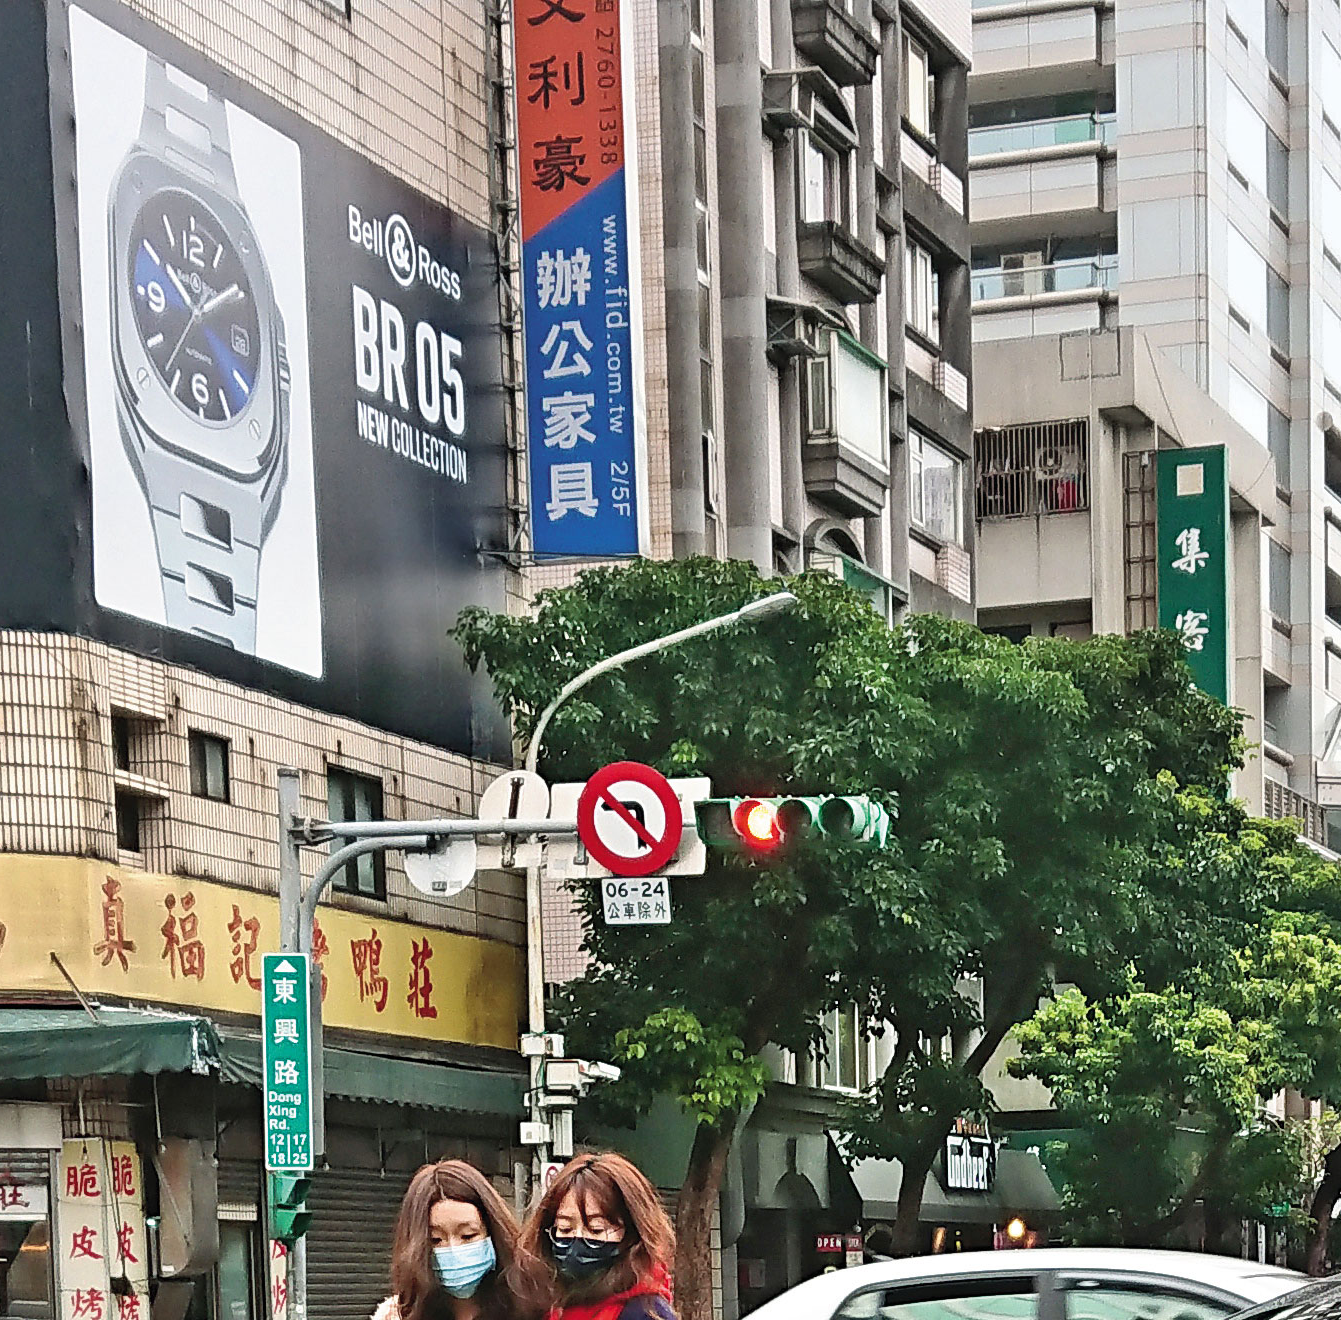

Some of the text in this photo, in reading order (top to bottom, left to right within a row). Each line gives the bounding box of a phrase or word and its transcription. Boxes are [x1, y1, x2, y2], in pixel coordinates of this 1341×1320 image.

[595, 27, 618, 165] 2760-1338
[182, 229, 205, 268] 12
[348, 204, 383, 257] Bell
[418, 243, 461, 301] Ross
[147, 280, 166, 313] 9
[353, 284, 465, 435] BR 05
[191, 373, 209, 405] 6
[536, 246, 598, 523] 辦公家具
[356, 399, 467, 485] NEW COLLECTION
[610, 459, 631, 518] 2/5F
[605, 880, 666, 898] 06-24
[607, 902, 668, 921] 公車除外
[272, 976, 300, 1085] 東興路
[268, 1091, 302, 1106] Dong
[268, 1105, 297, 1120] Xing
[269, 1119, 290, 1131] Rd.
[270, 1134, 307, 1146] 12 17
[271, 1153, 308, 1165] 18 25
[817, 1237, 842, 1248] OPEN
